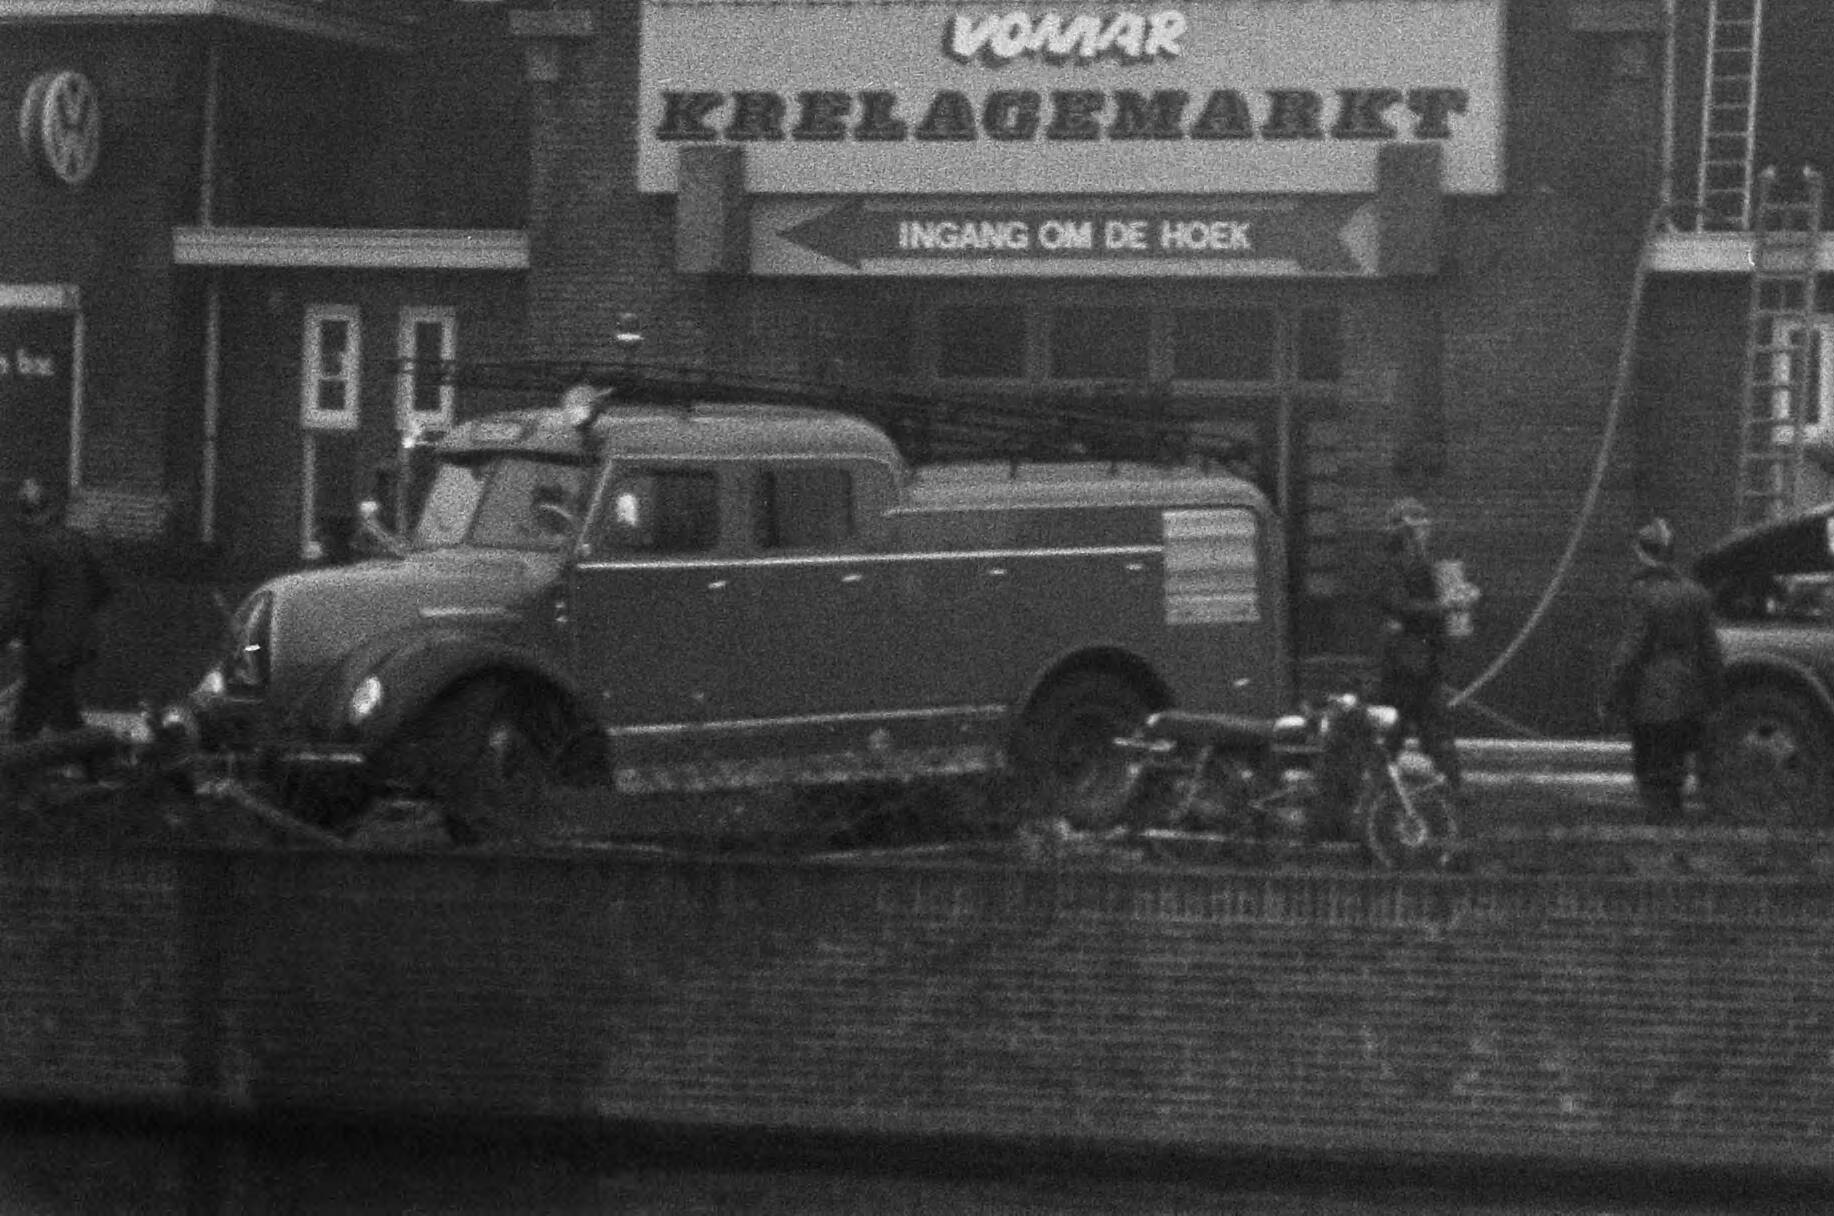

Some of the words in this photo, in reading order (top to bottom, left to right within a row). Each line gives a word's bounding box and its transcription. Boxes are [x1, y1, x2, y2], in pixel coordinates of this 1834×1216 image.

[943, 9, 1187, 68] VOMAR
[658, 88, 1468, 141] KRELAGEMARKT
[898, 220, 1029, 250] INGANG
[1038, 220, 1093, 250] OM
[1105, 220, 1149, 250] DE
[1160, 220, 1252, 250] HOEK
